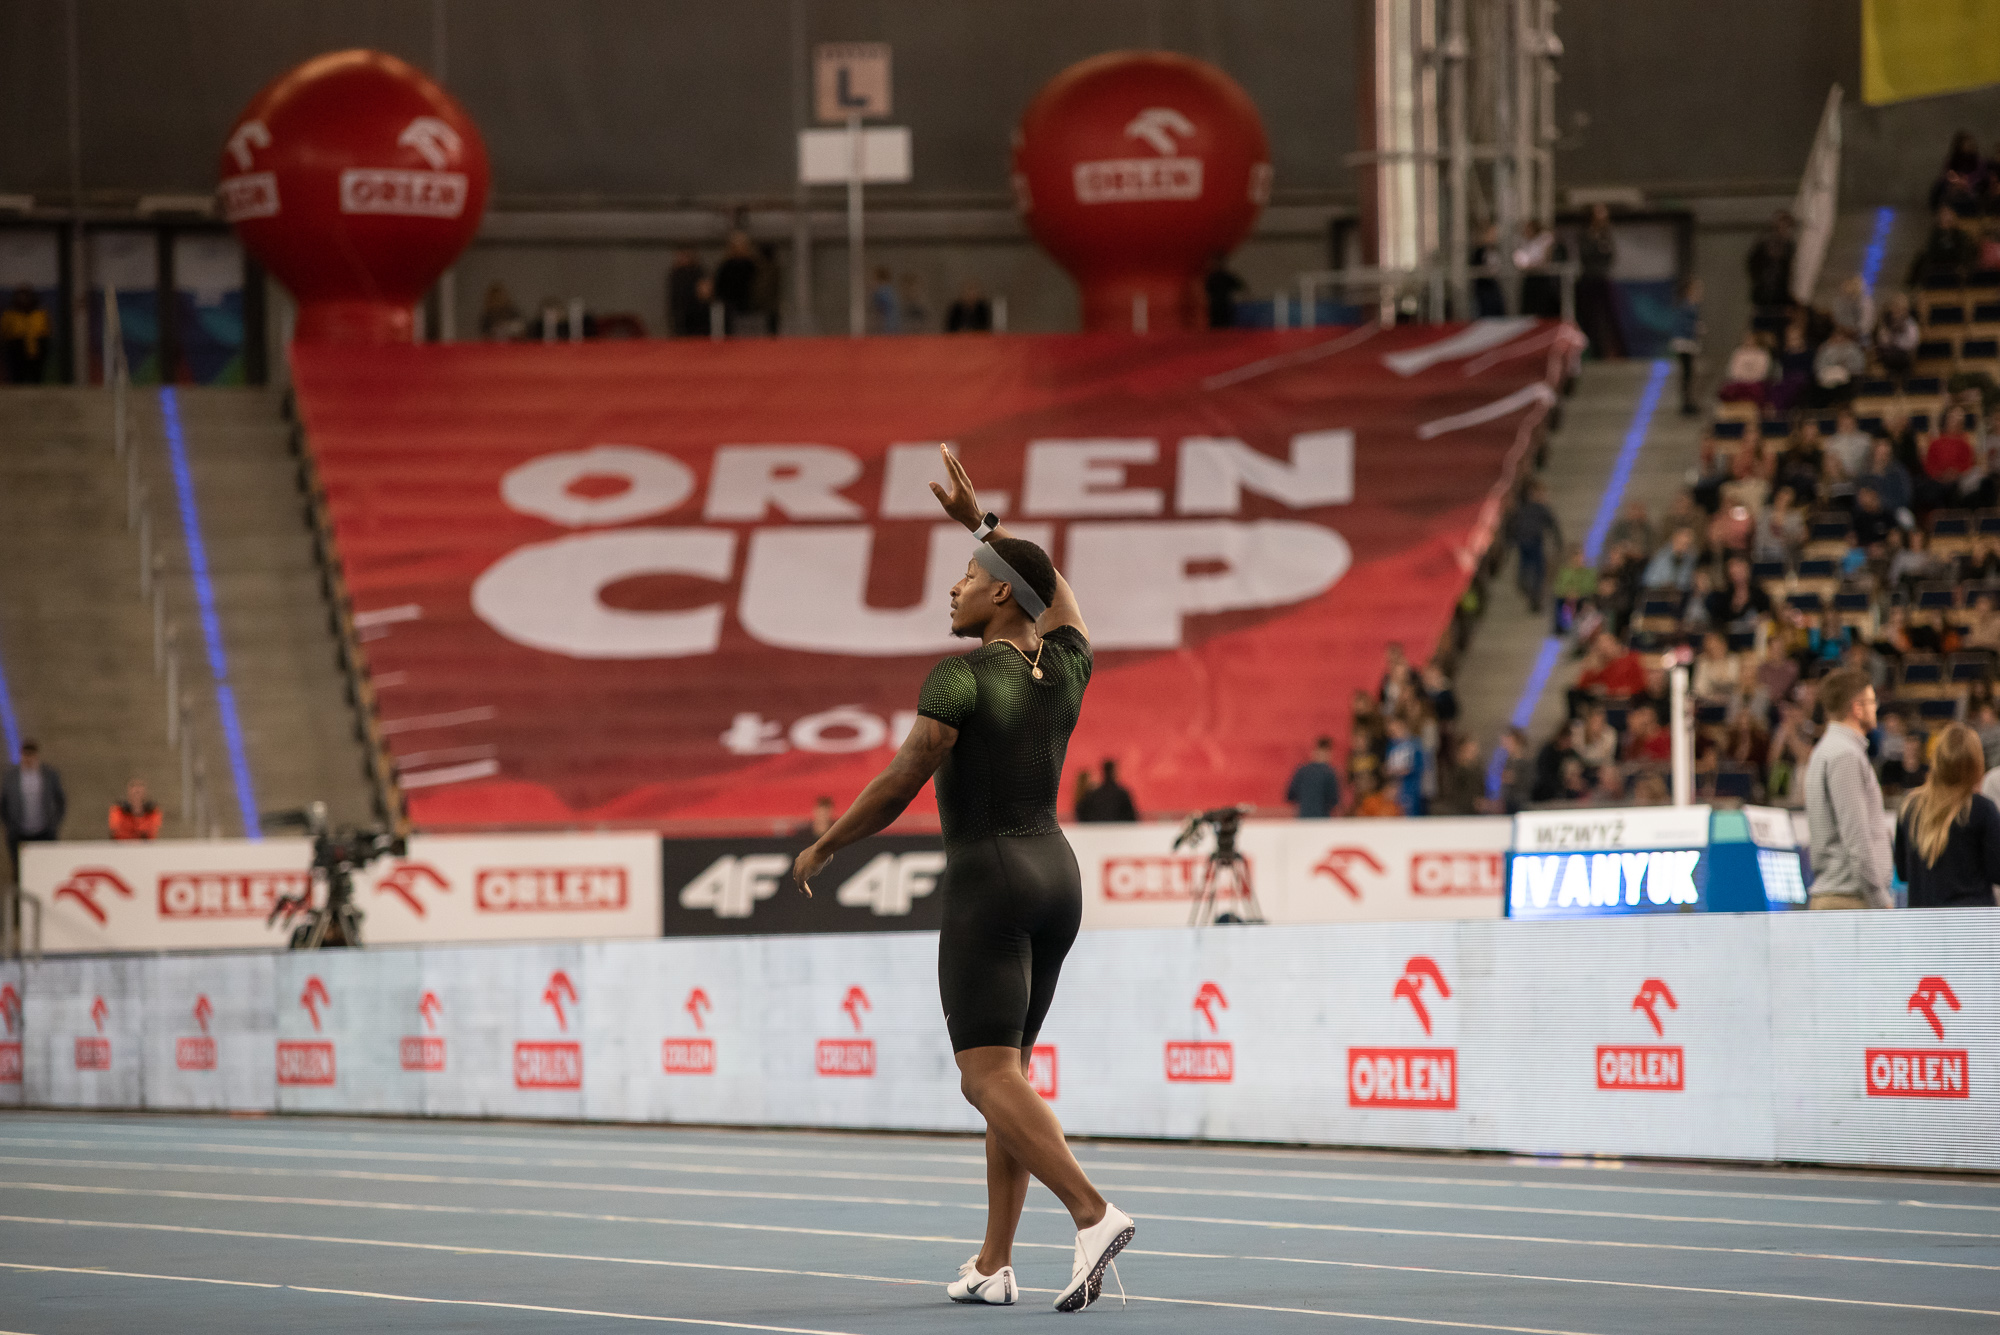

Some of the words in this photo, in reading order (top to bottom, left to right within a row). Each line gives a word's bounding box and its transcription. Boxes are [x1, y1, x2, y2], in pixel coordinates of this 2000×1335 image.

[837, 67, 867, 107] L
[501, 428, 1354, 528] ORLEN
[471, 518, 1353, 659] CUP
[485, 871, 617, 903] ORLEN
[678, 853, 793, 918] 4F
[836, 851, 948, 915] 4F
[1511, 851, 1700, 907] IVANYUK
[1351, 1055, 1451, 1101] ORLEN
[1600, 1053, 1679, 1086] ORLEN
[1870, 1054, 1963, 1091] ORLEN
